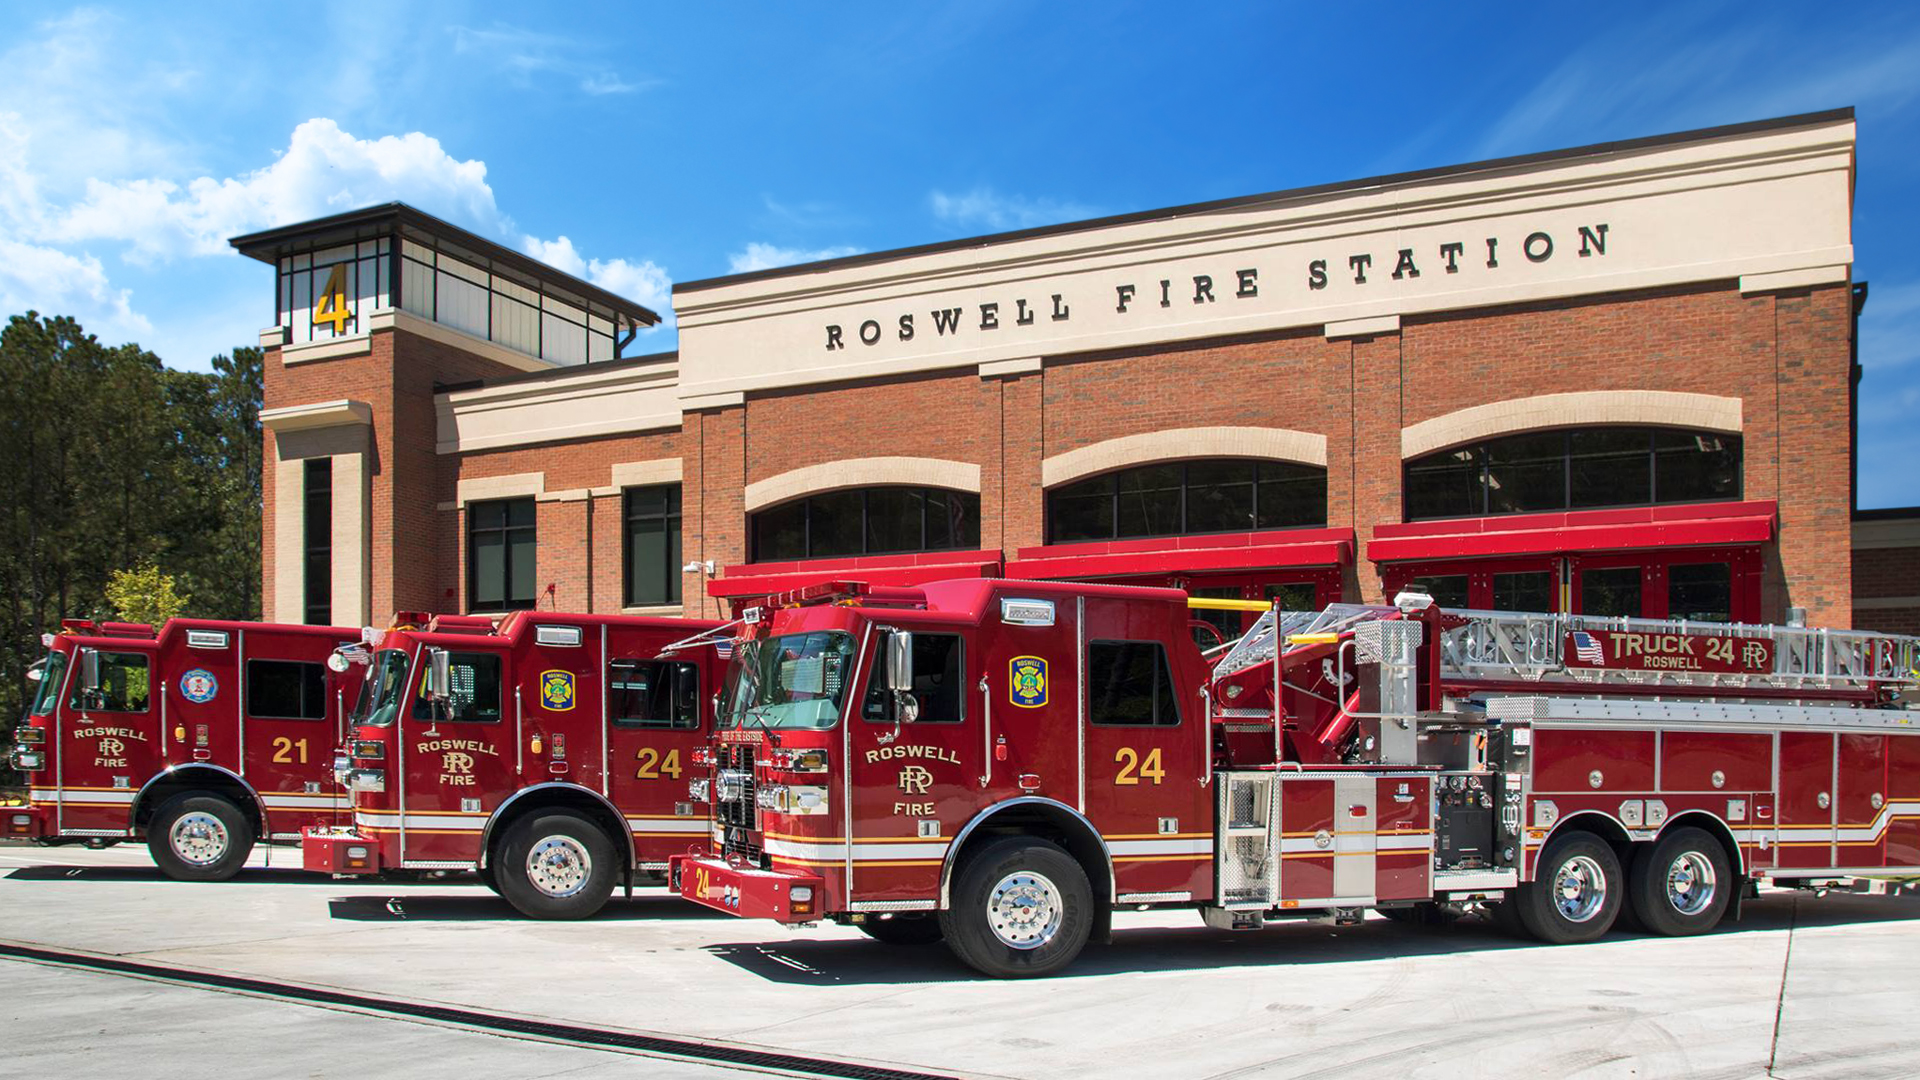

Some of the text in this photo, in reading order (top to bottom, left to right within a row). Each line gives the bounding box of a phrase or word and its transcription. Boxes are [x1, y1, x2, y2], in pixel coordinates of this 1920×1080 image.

[312, 262, 350, 333] 4
[825, 224, 1609, 350] ROSWELL FIRE STATION
[1609, 633, 1735, 665] TRUCK 24
[1643, 655, 1702, 670] ROSWELL
[73, 727, 148, 742] ROSWELL
[271, 737, 308, 764] 21
[417, 739, 500, 757] ROSWELL
[865, 745, 962, 765] ROSWELL
[94, 757, 128, 768] FIRE
[636, 747, 683, 779] 24
[1114, 746, 1166, 785] 24
[439, 773, 476, 786] FIRE
[893, 802, 936, 817] FIRE
[695, 867, 710, 900] 24
